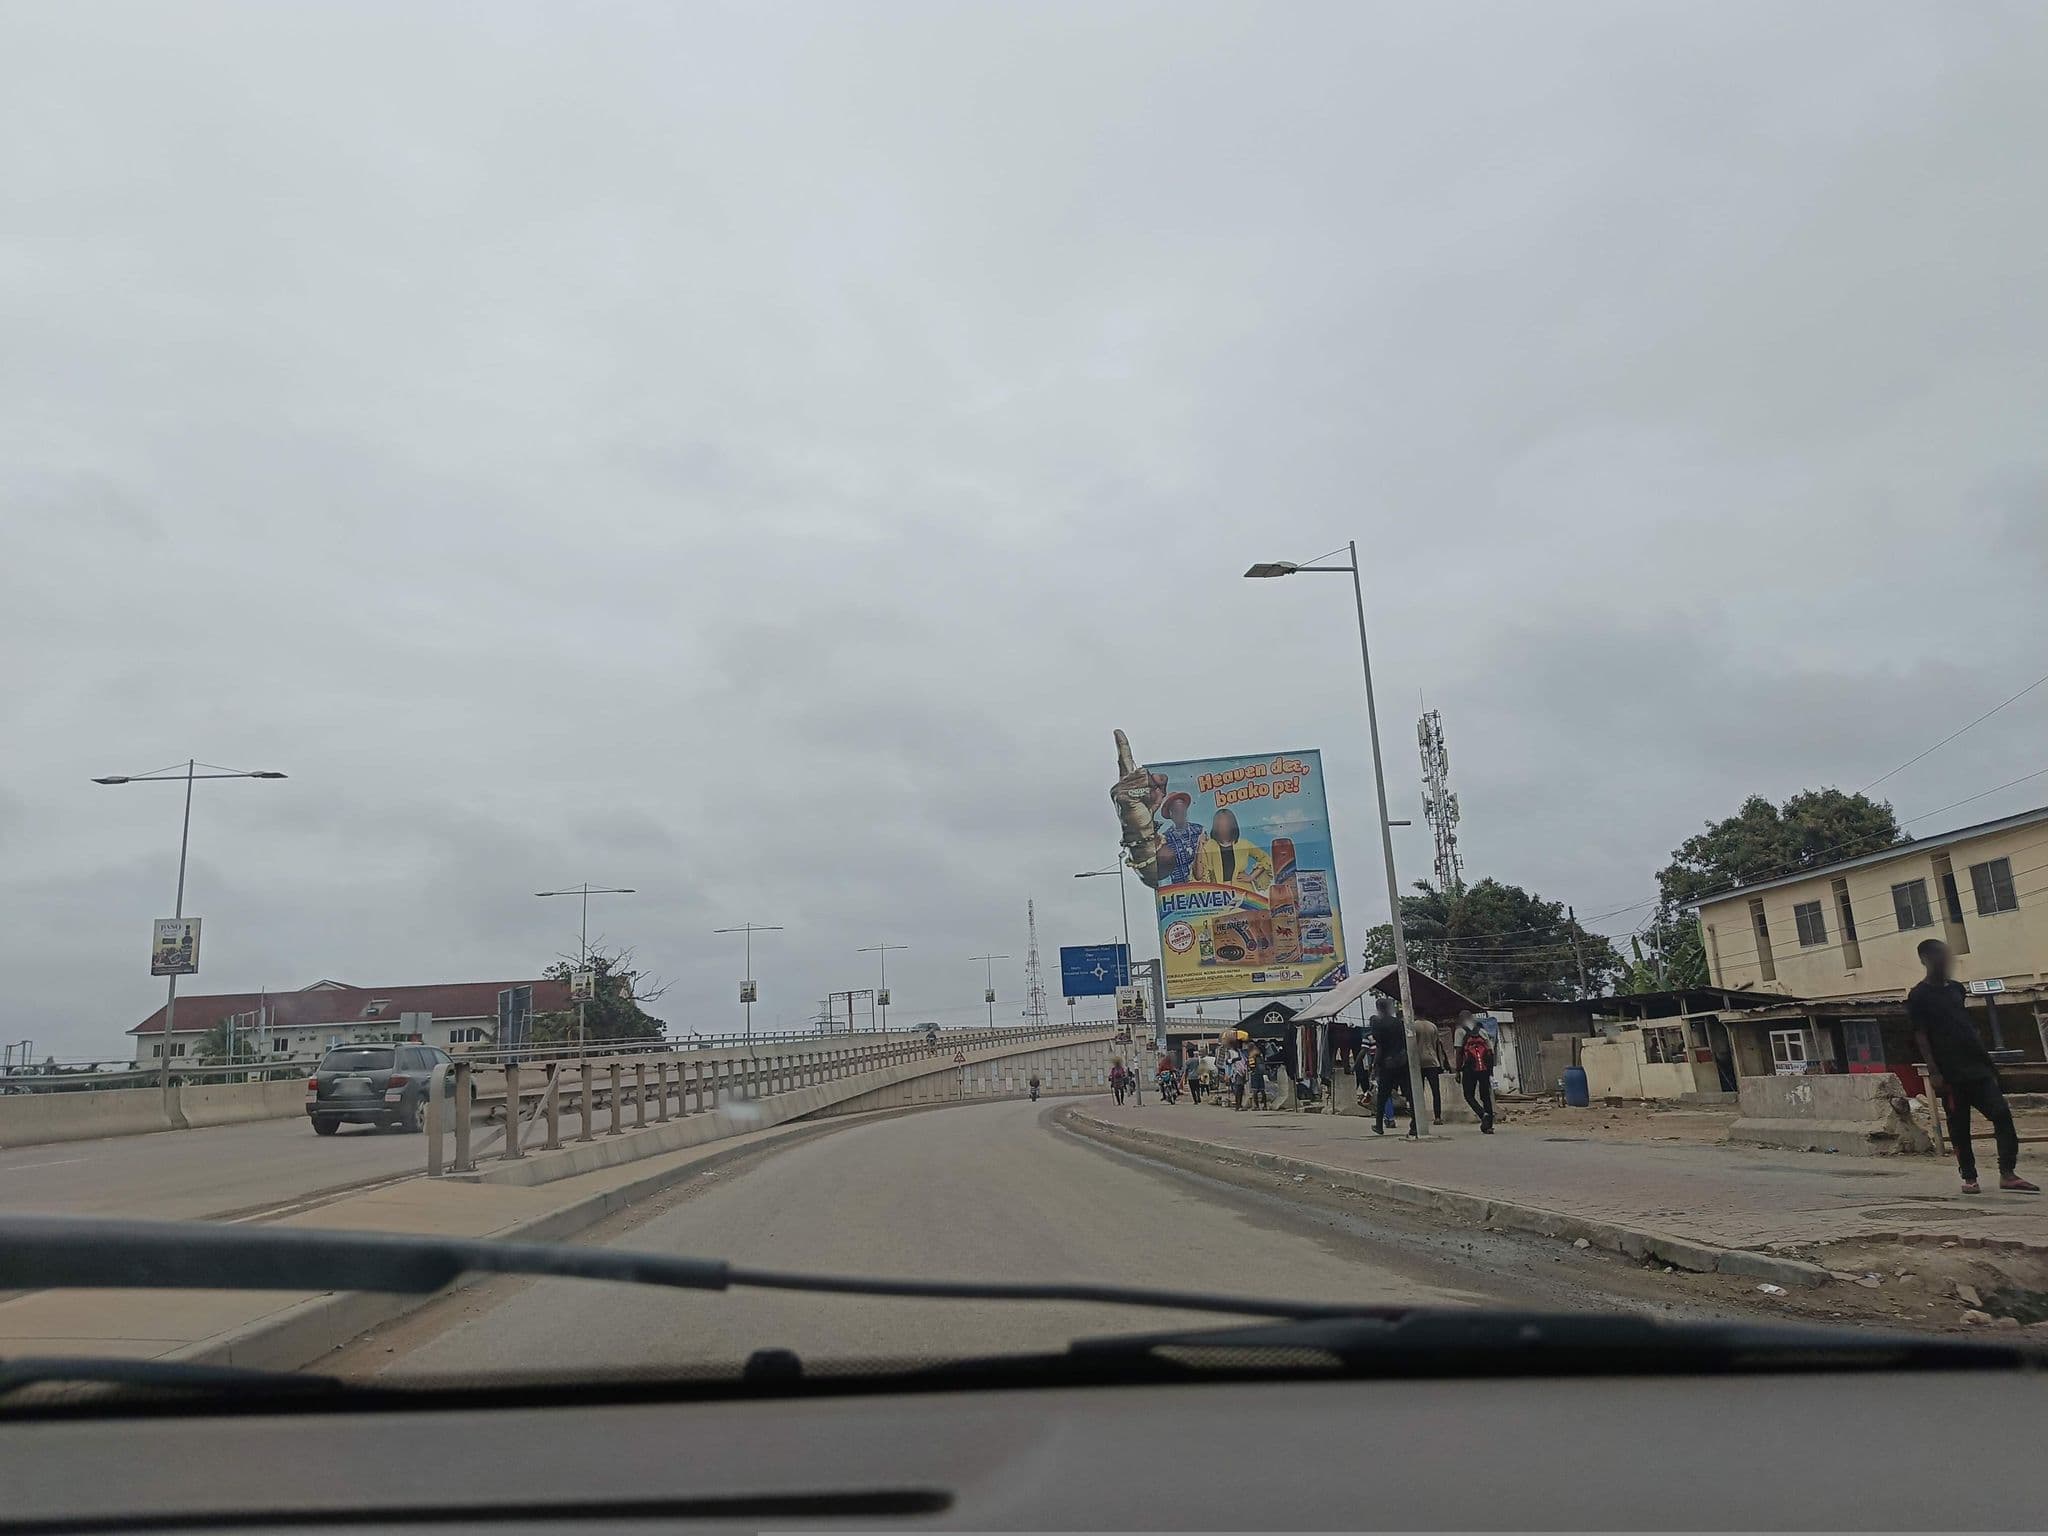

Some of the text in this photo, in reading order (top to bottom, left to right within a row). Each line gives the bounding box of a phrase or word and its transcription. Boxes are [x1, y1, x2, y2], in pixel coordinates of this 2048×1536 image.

[1198, 764, 1267, 793] Heaven
[1215, 782, 1269, 807] baako
[1162, 890, 1235, 912] HEAVEN
